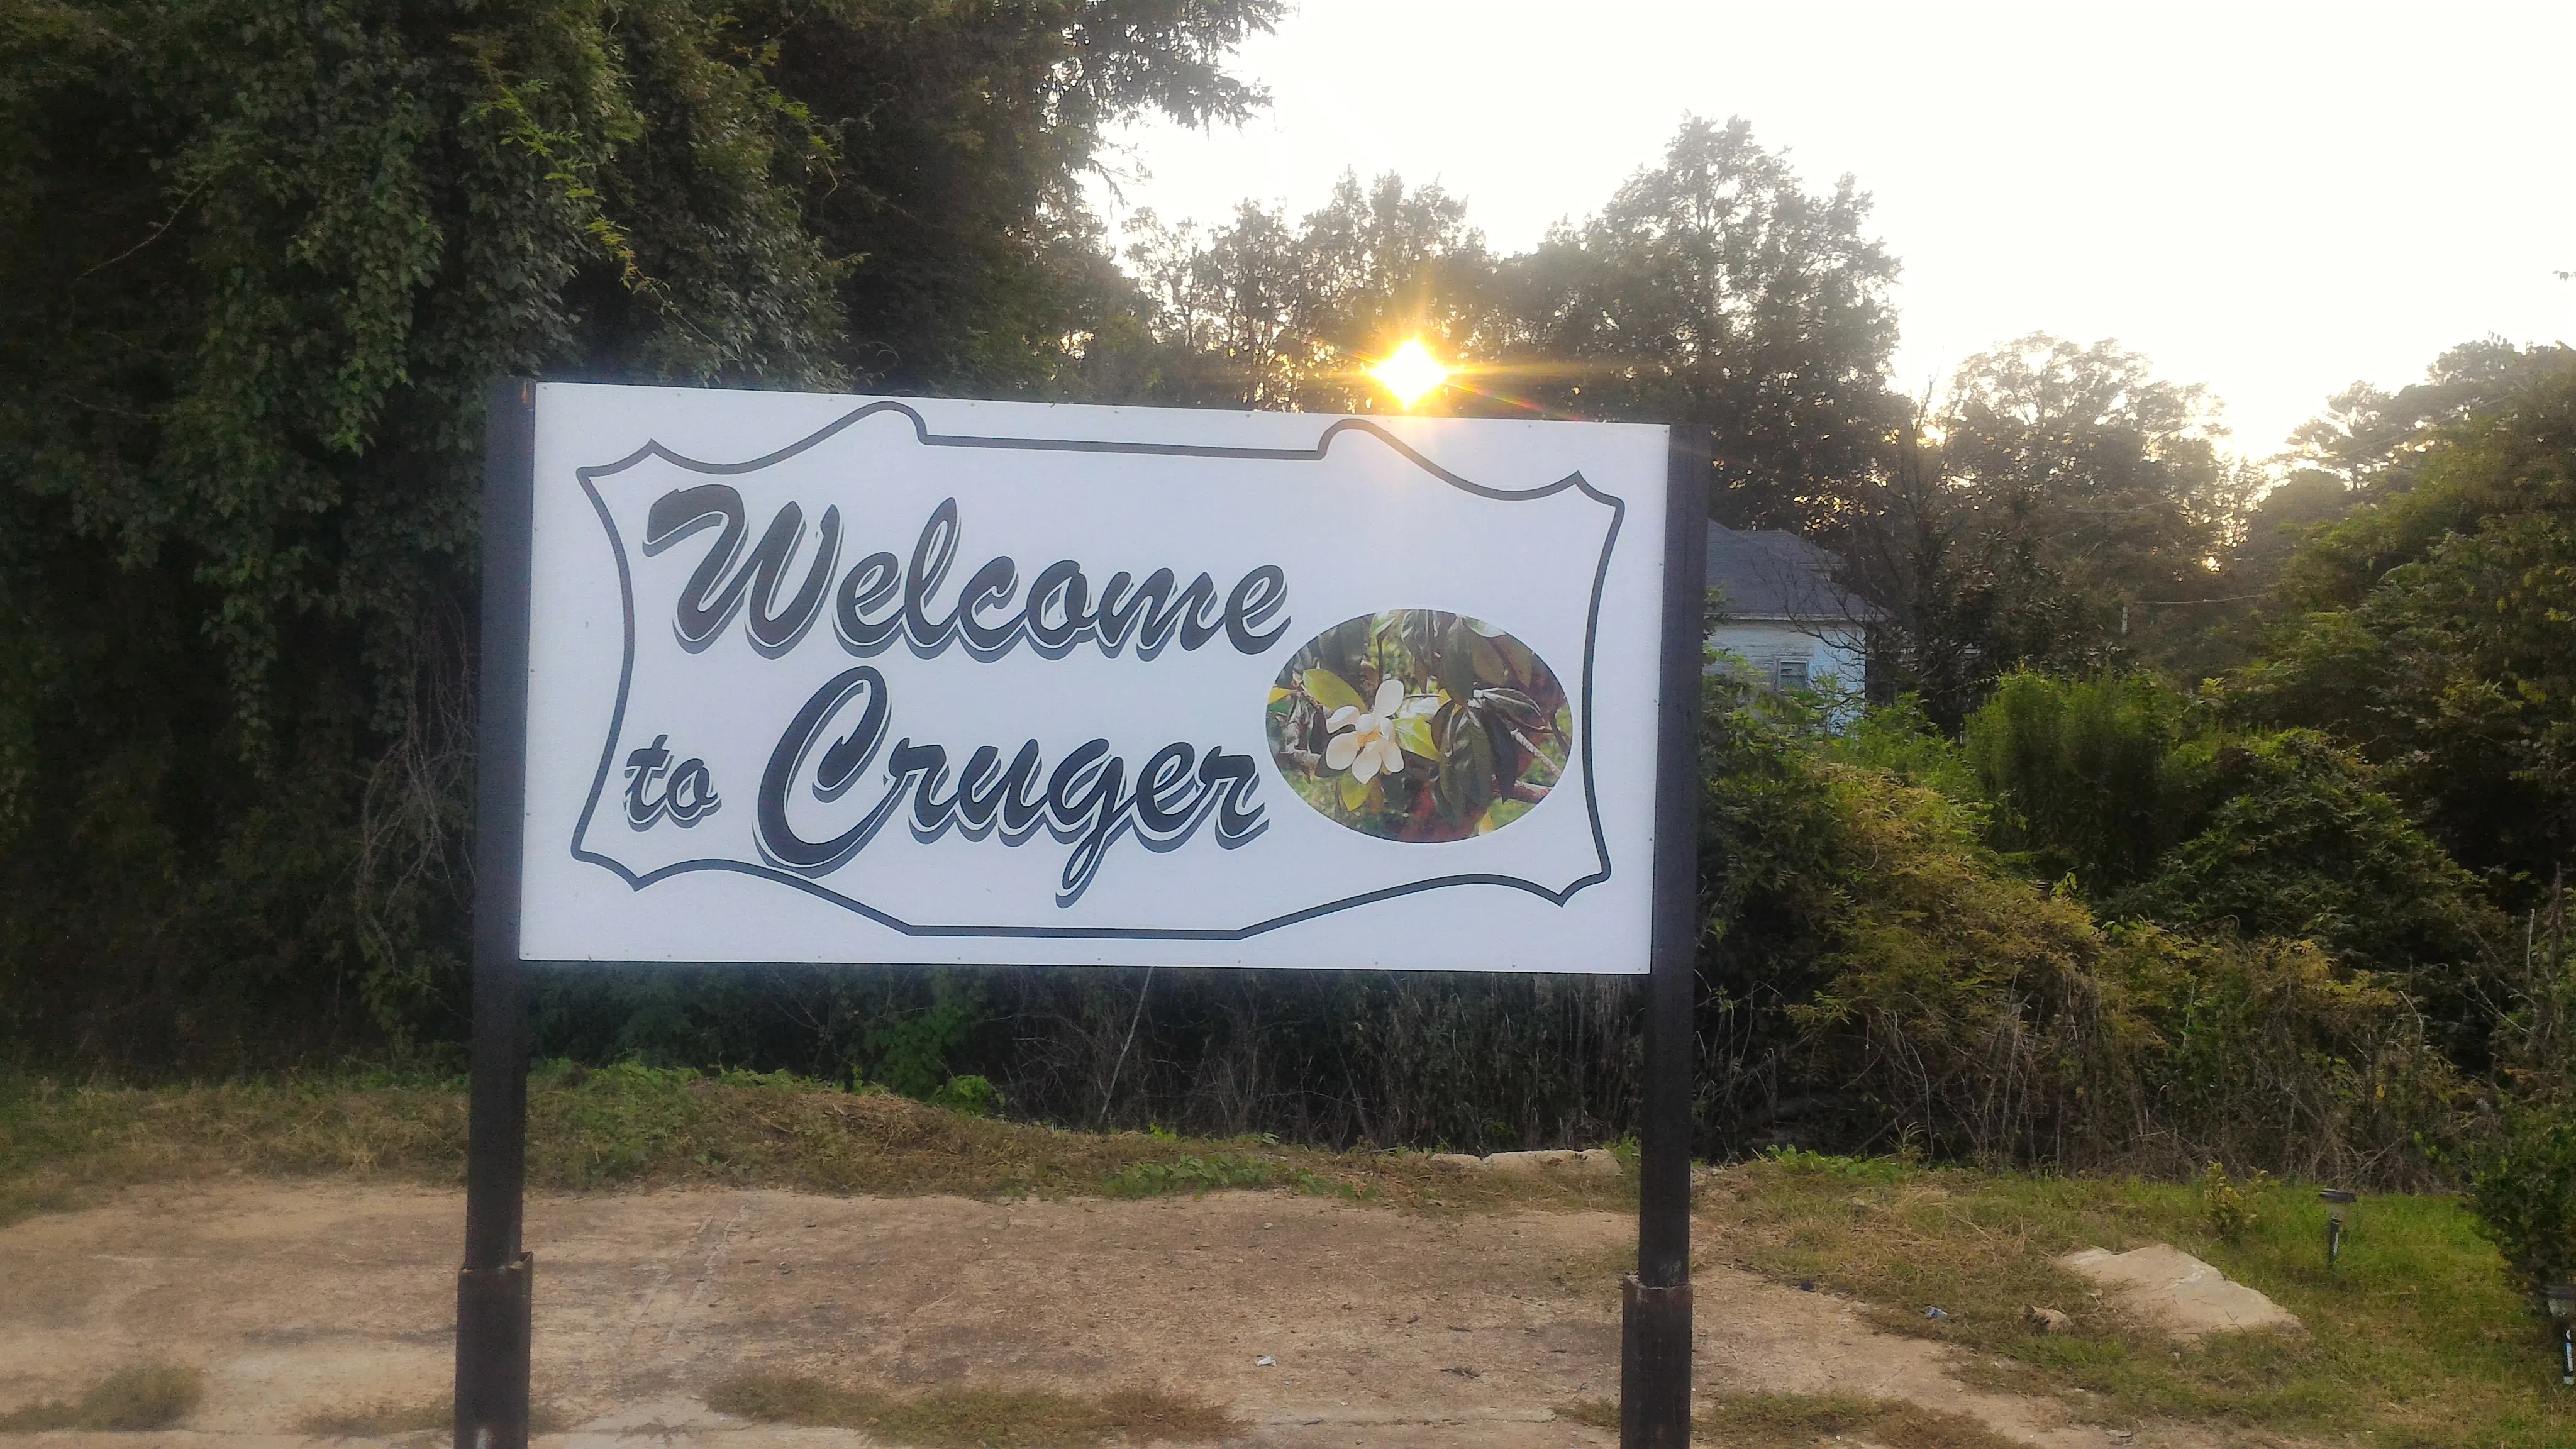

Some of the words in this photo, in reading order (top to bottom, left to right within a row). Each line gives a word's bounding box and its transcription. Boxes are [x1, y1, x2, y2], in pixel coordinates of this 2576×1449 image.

[642, 483, 1292, 661] Welcome
[625, 733, 721, 831] to
[753, 666, 1270, 909] Cruger
